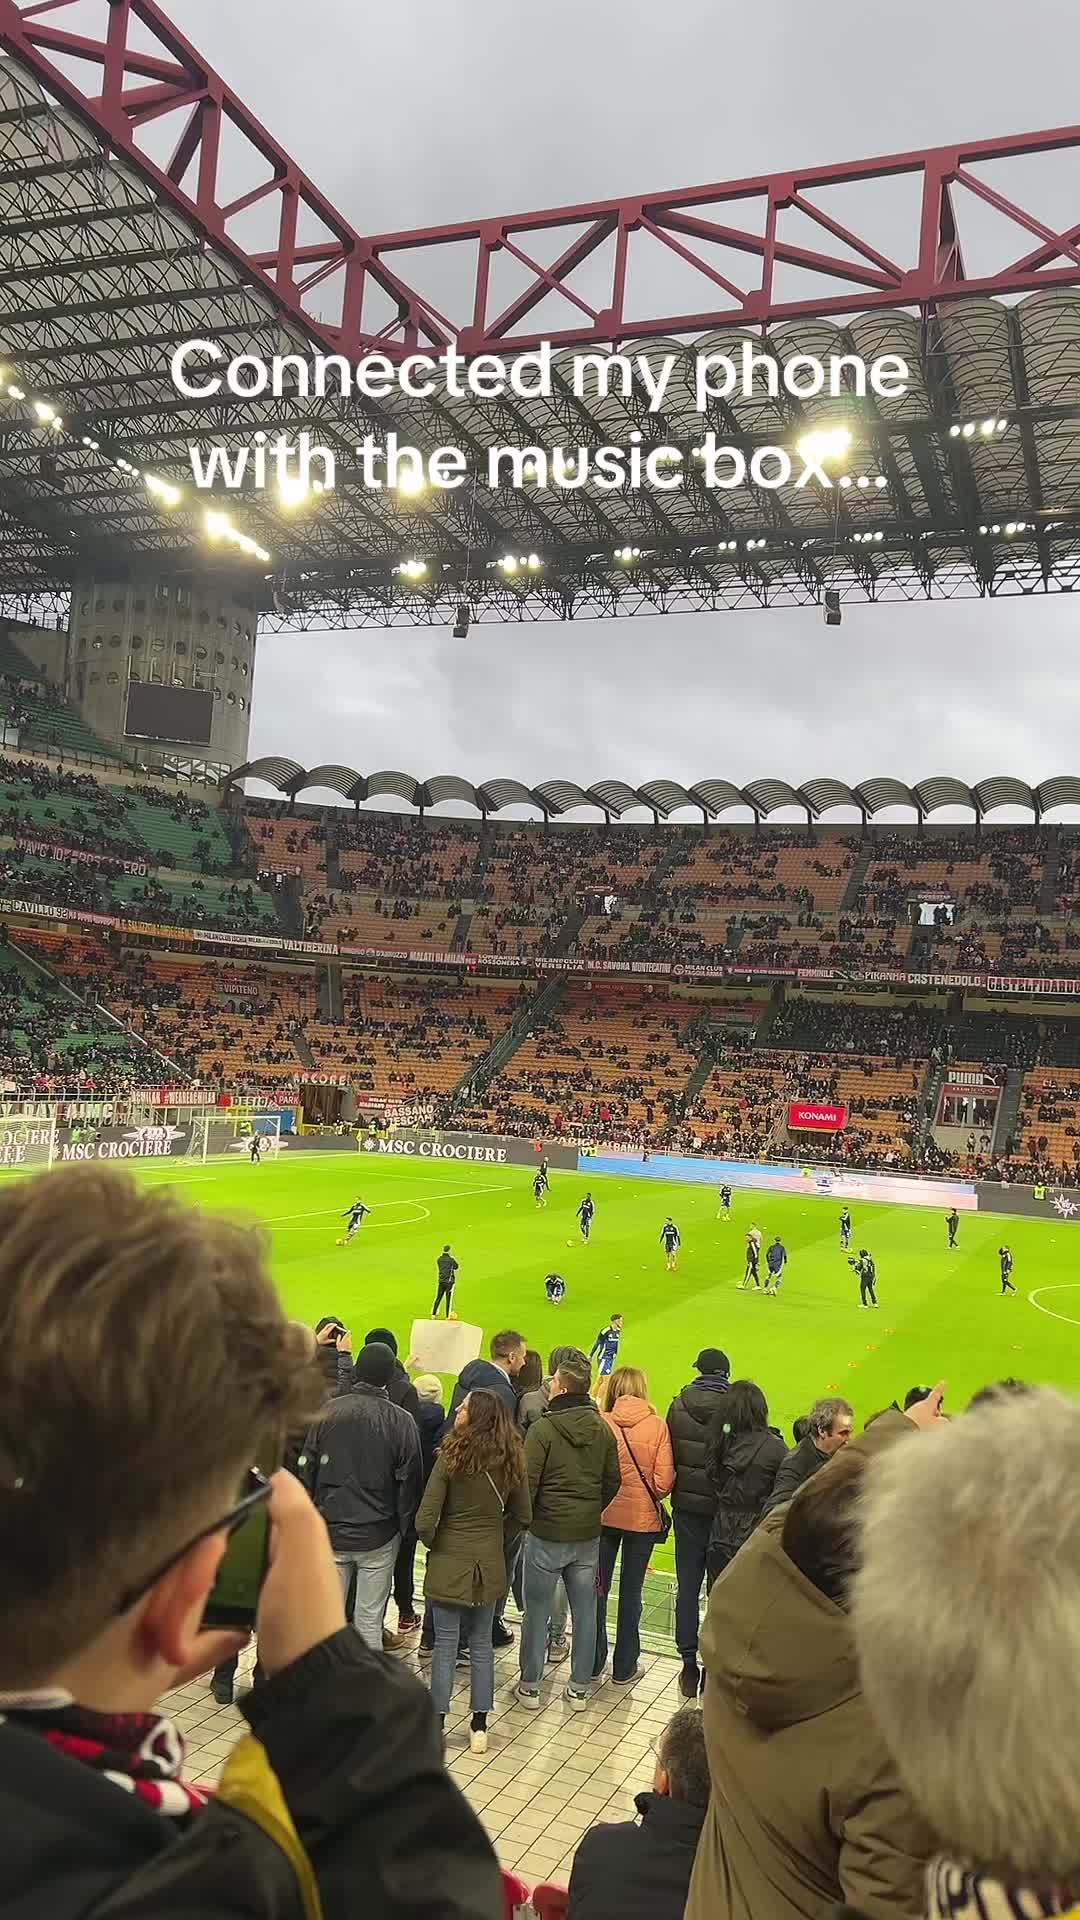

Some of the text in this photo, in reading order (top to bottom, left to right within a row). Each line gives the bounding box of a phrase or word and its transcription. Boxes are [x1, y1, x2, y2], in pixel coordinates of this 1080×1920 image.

[284, 940, 339, 955] VALTIBERINA
[535, 962, 585, 971] VERSILIA
[602, 961, 631, 971] SAVONA
[684, 963, 724, 972] MILAN CLUB
[797, 967, 835, 979] FEMMINILE
[223, 983, 259, 996] VIPITENO
[948, 1071, 984, 1085] PUMA
[233, 1096, 269, 1107] DESIO
[384, 1104, 434, 1118] BASSANO
[798, 1111, 837, 1121] KONAMI
[61, 1140, 172, 1160] MSC CROCIERE
[377, 1138, 508, 1163] MSC CROCIERE
